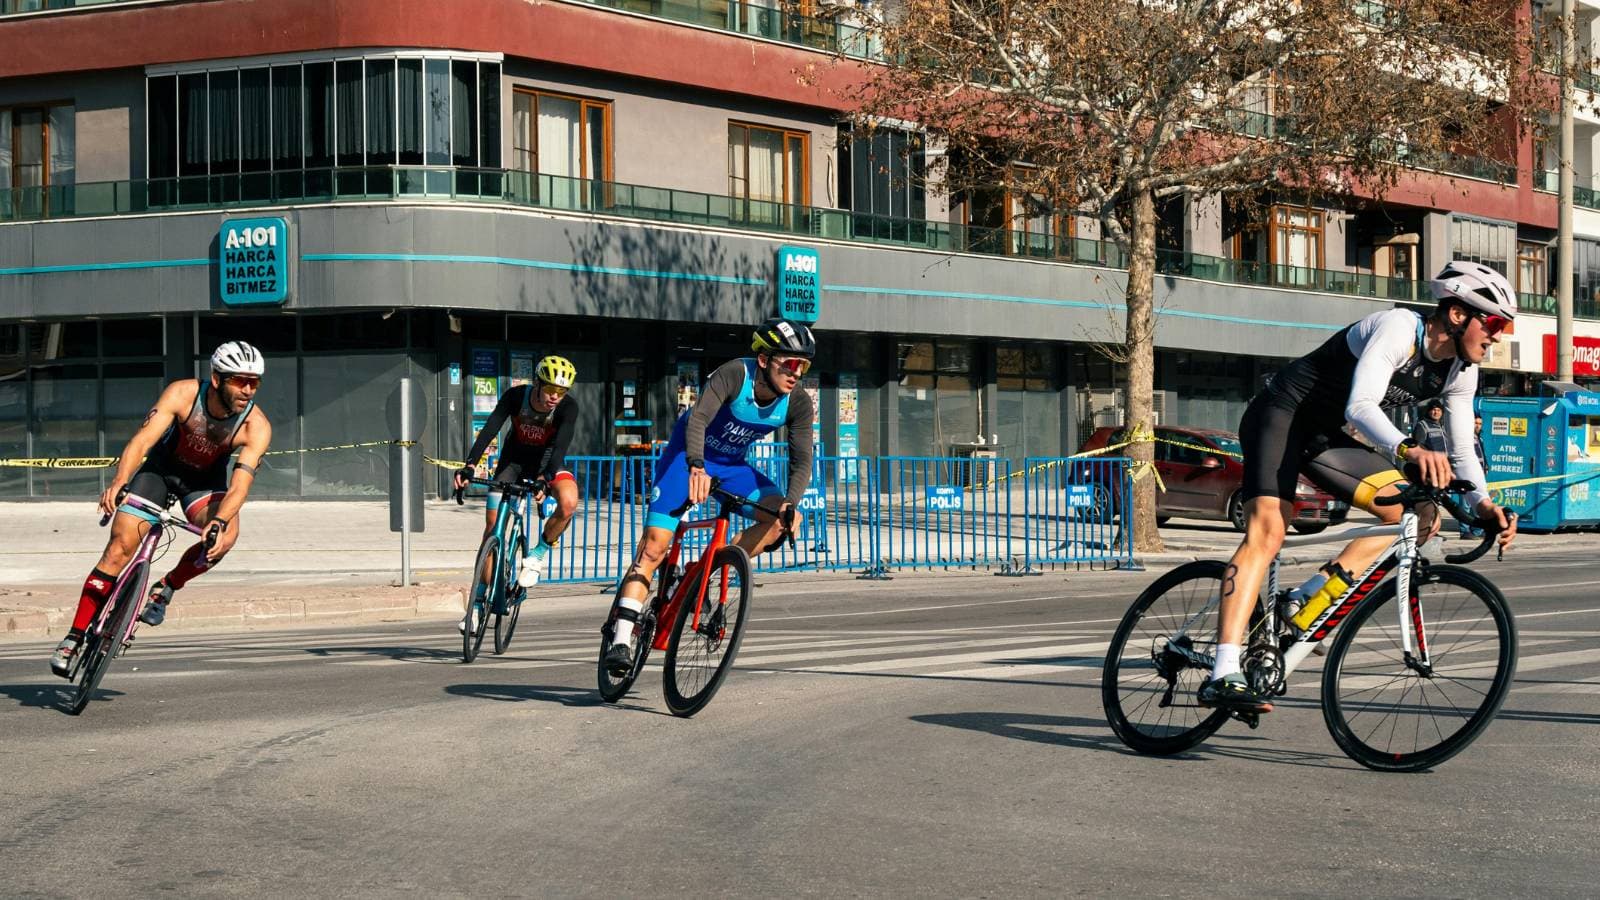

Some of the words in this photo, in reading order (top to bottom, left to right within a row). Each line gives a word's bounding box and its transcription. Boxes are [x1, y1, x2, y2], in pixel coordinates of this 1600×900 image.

[226, 250, 276, 264] HARCA
[226, 265, 276, 279] HARCA
[785, 273, 815, 287] HARCA
[785, 287, 815, 300] HARCA
[1453, 284, 1460, 292] 3
[721, 430, 751, 446] TUR
[1499, 445, 1517, 453] ATIK
[1504, 488, 1527, 498] SIFIR
[1504, 498, 1526, 507] ATIK
